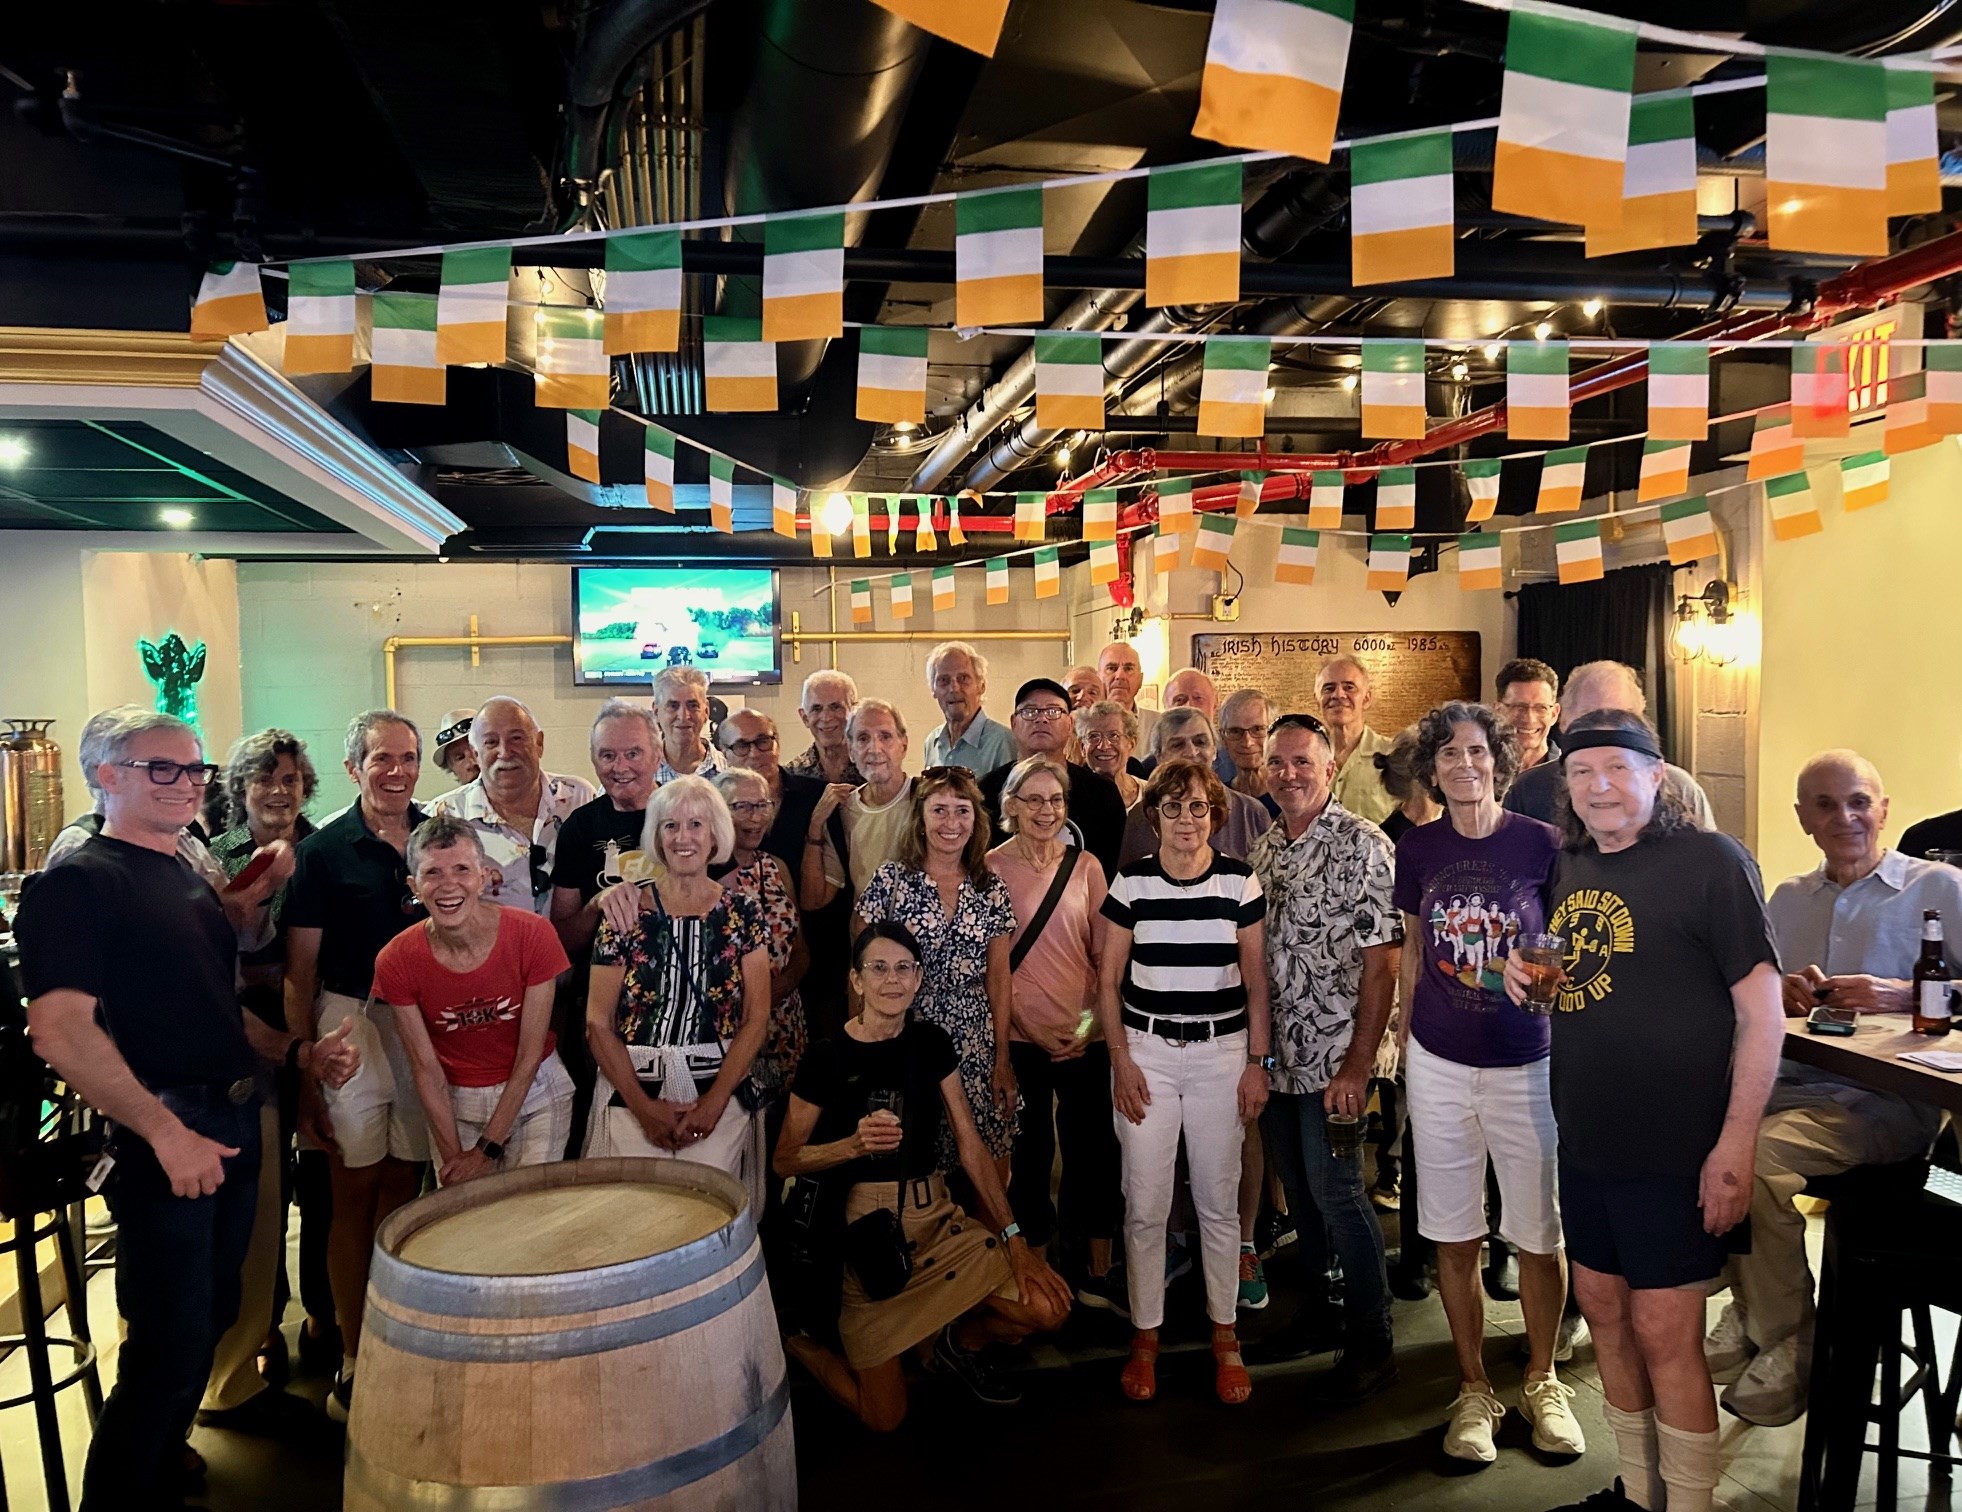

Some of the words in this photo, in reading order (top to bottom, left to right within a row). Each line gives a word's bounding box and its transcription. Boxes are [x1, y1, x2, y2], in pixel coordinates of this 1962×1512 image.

[1407, 636, 1438, 652] 1985
[1567, 889, 1600, 912] SAID
[1596, 891, 1625, 916] SIT
[1548, 901, 1567, 934] HEY
[1609, 906, 1635, 953] DOWN
[1599, 945, 1608, 958] A
[1558, 990, 1586, 1012] OOD
[1587, 973, 1613, 1001] UP
